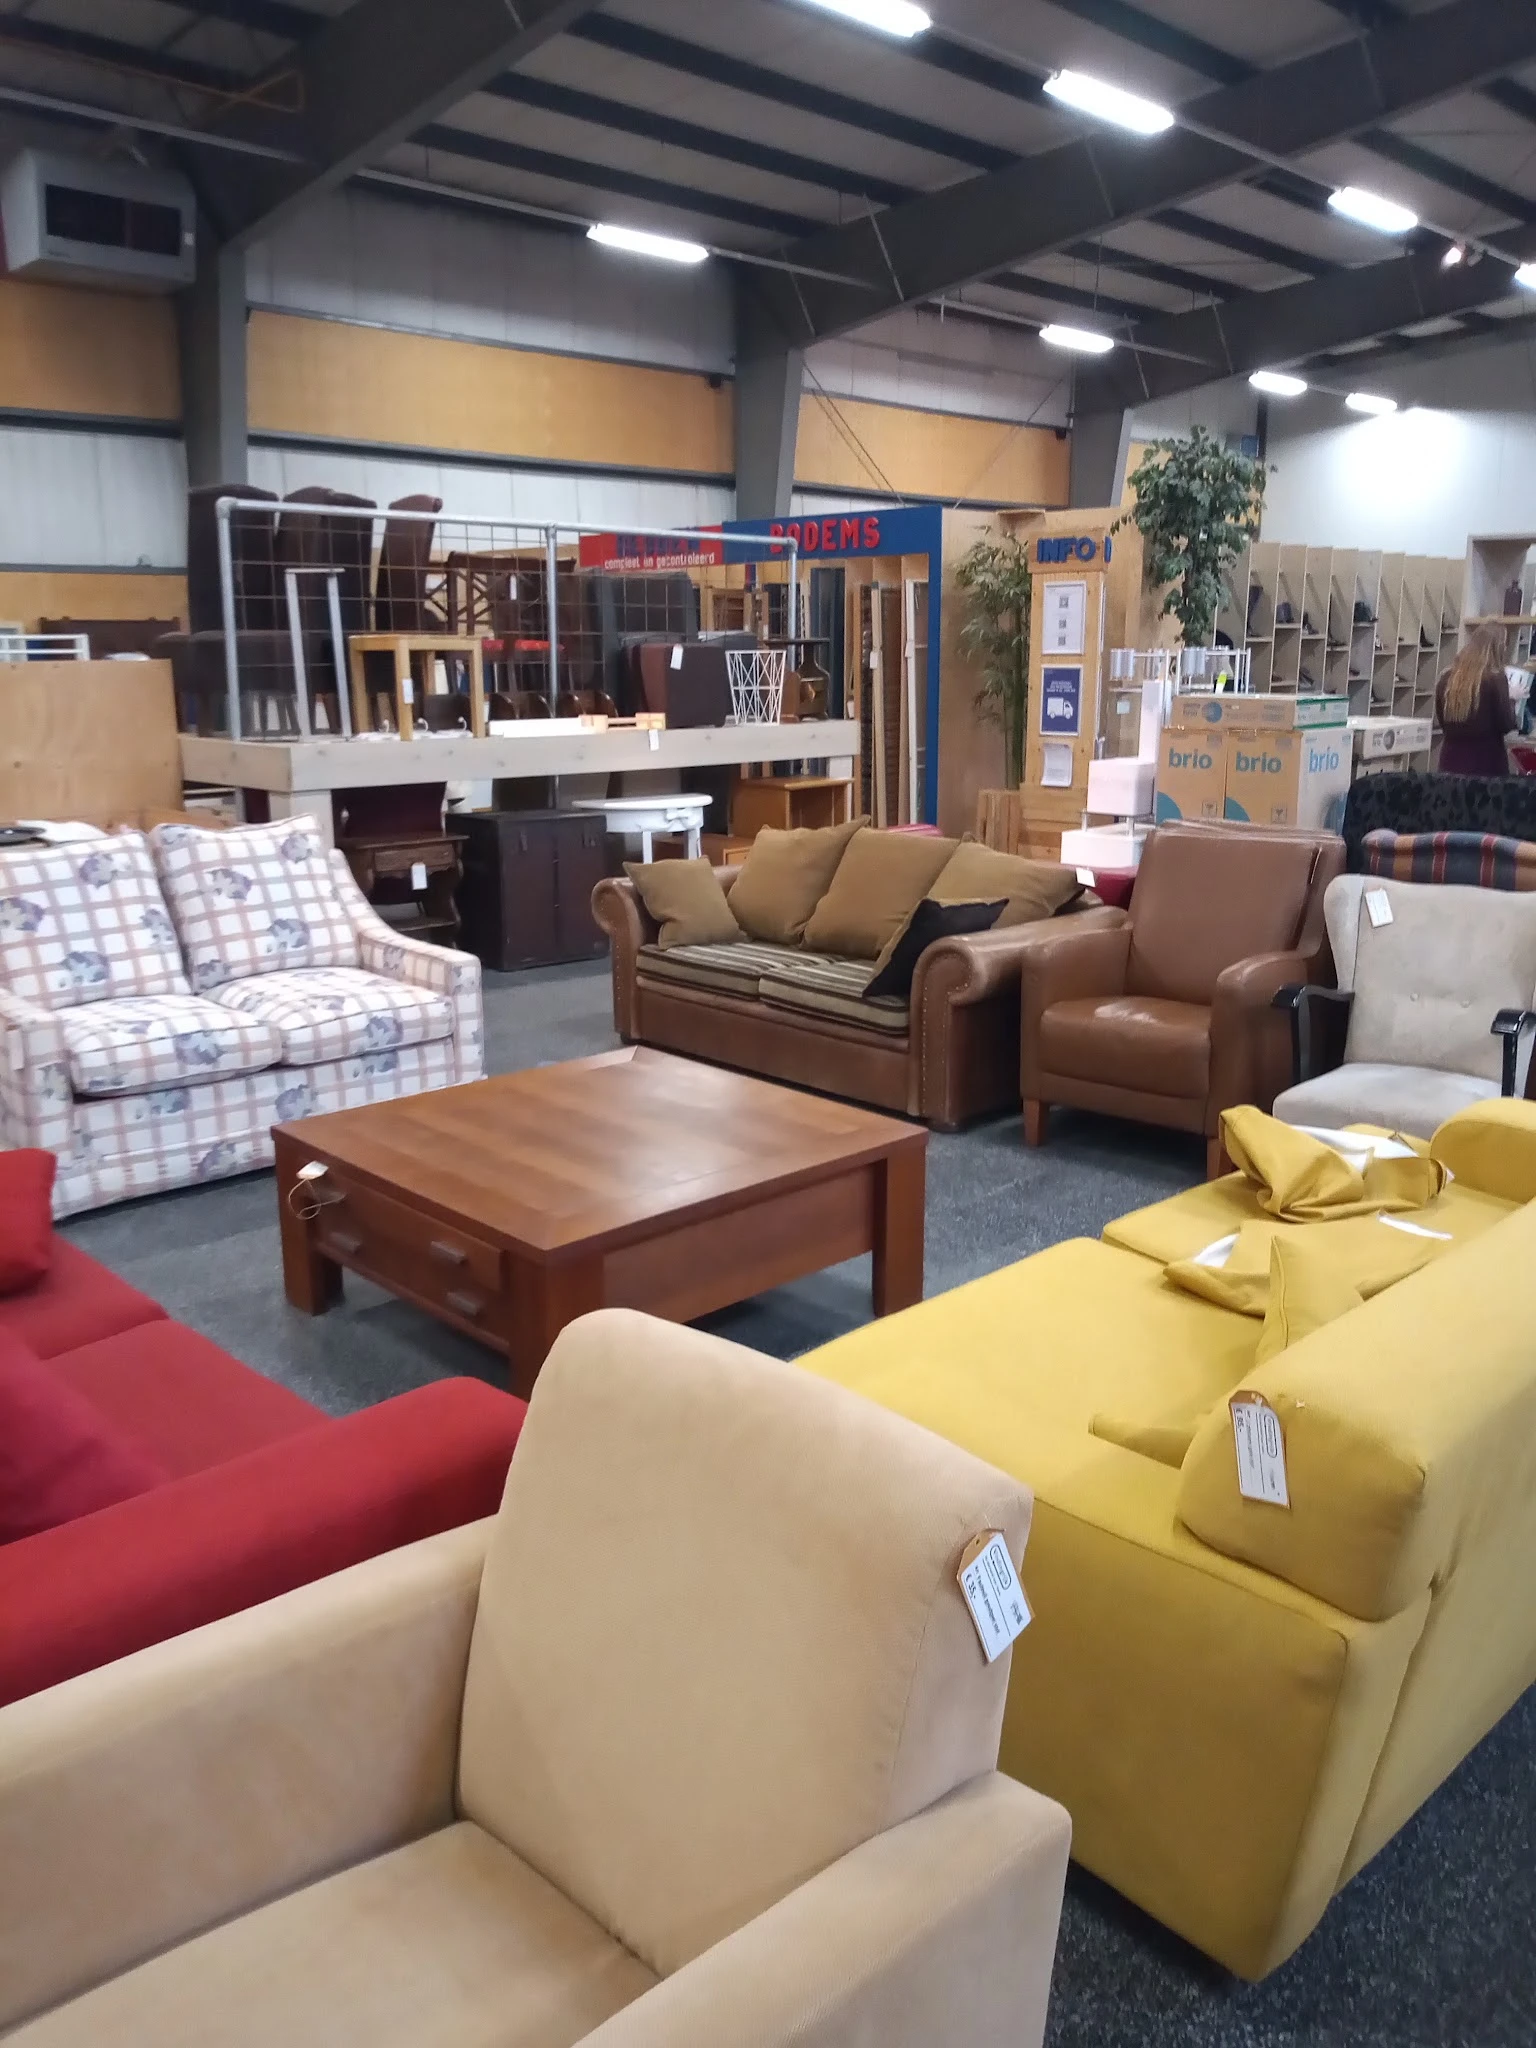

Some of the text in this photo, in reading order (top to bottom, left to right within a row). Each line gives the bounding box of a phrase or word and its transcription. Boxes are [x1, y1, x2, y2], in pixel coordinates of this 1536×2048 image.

[770, 517, 880, 553] BODEMS
[1037, 537, 1097, 563] INFO
[1168, 748, 1213, 770] brio
[1235, 751, 1282, 774] brio
[1308, 746, 1340, 774] brio
